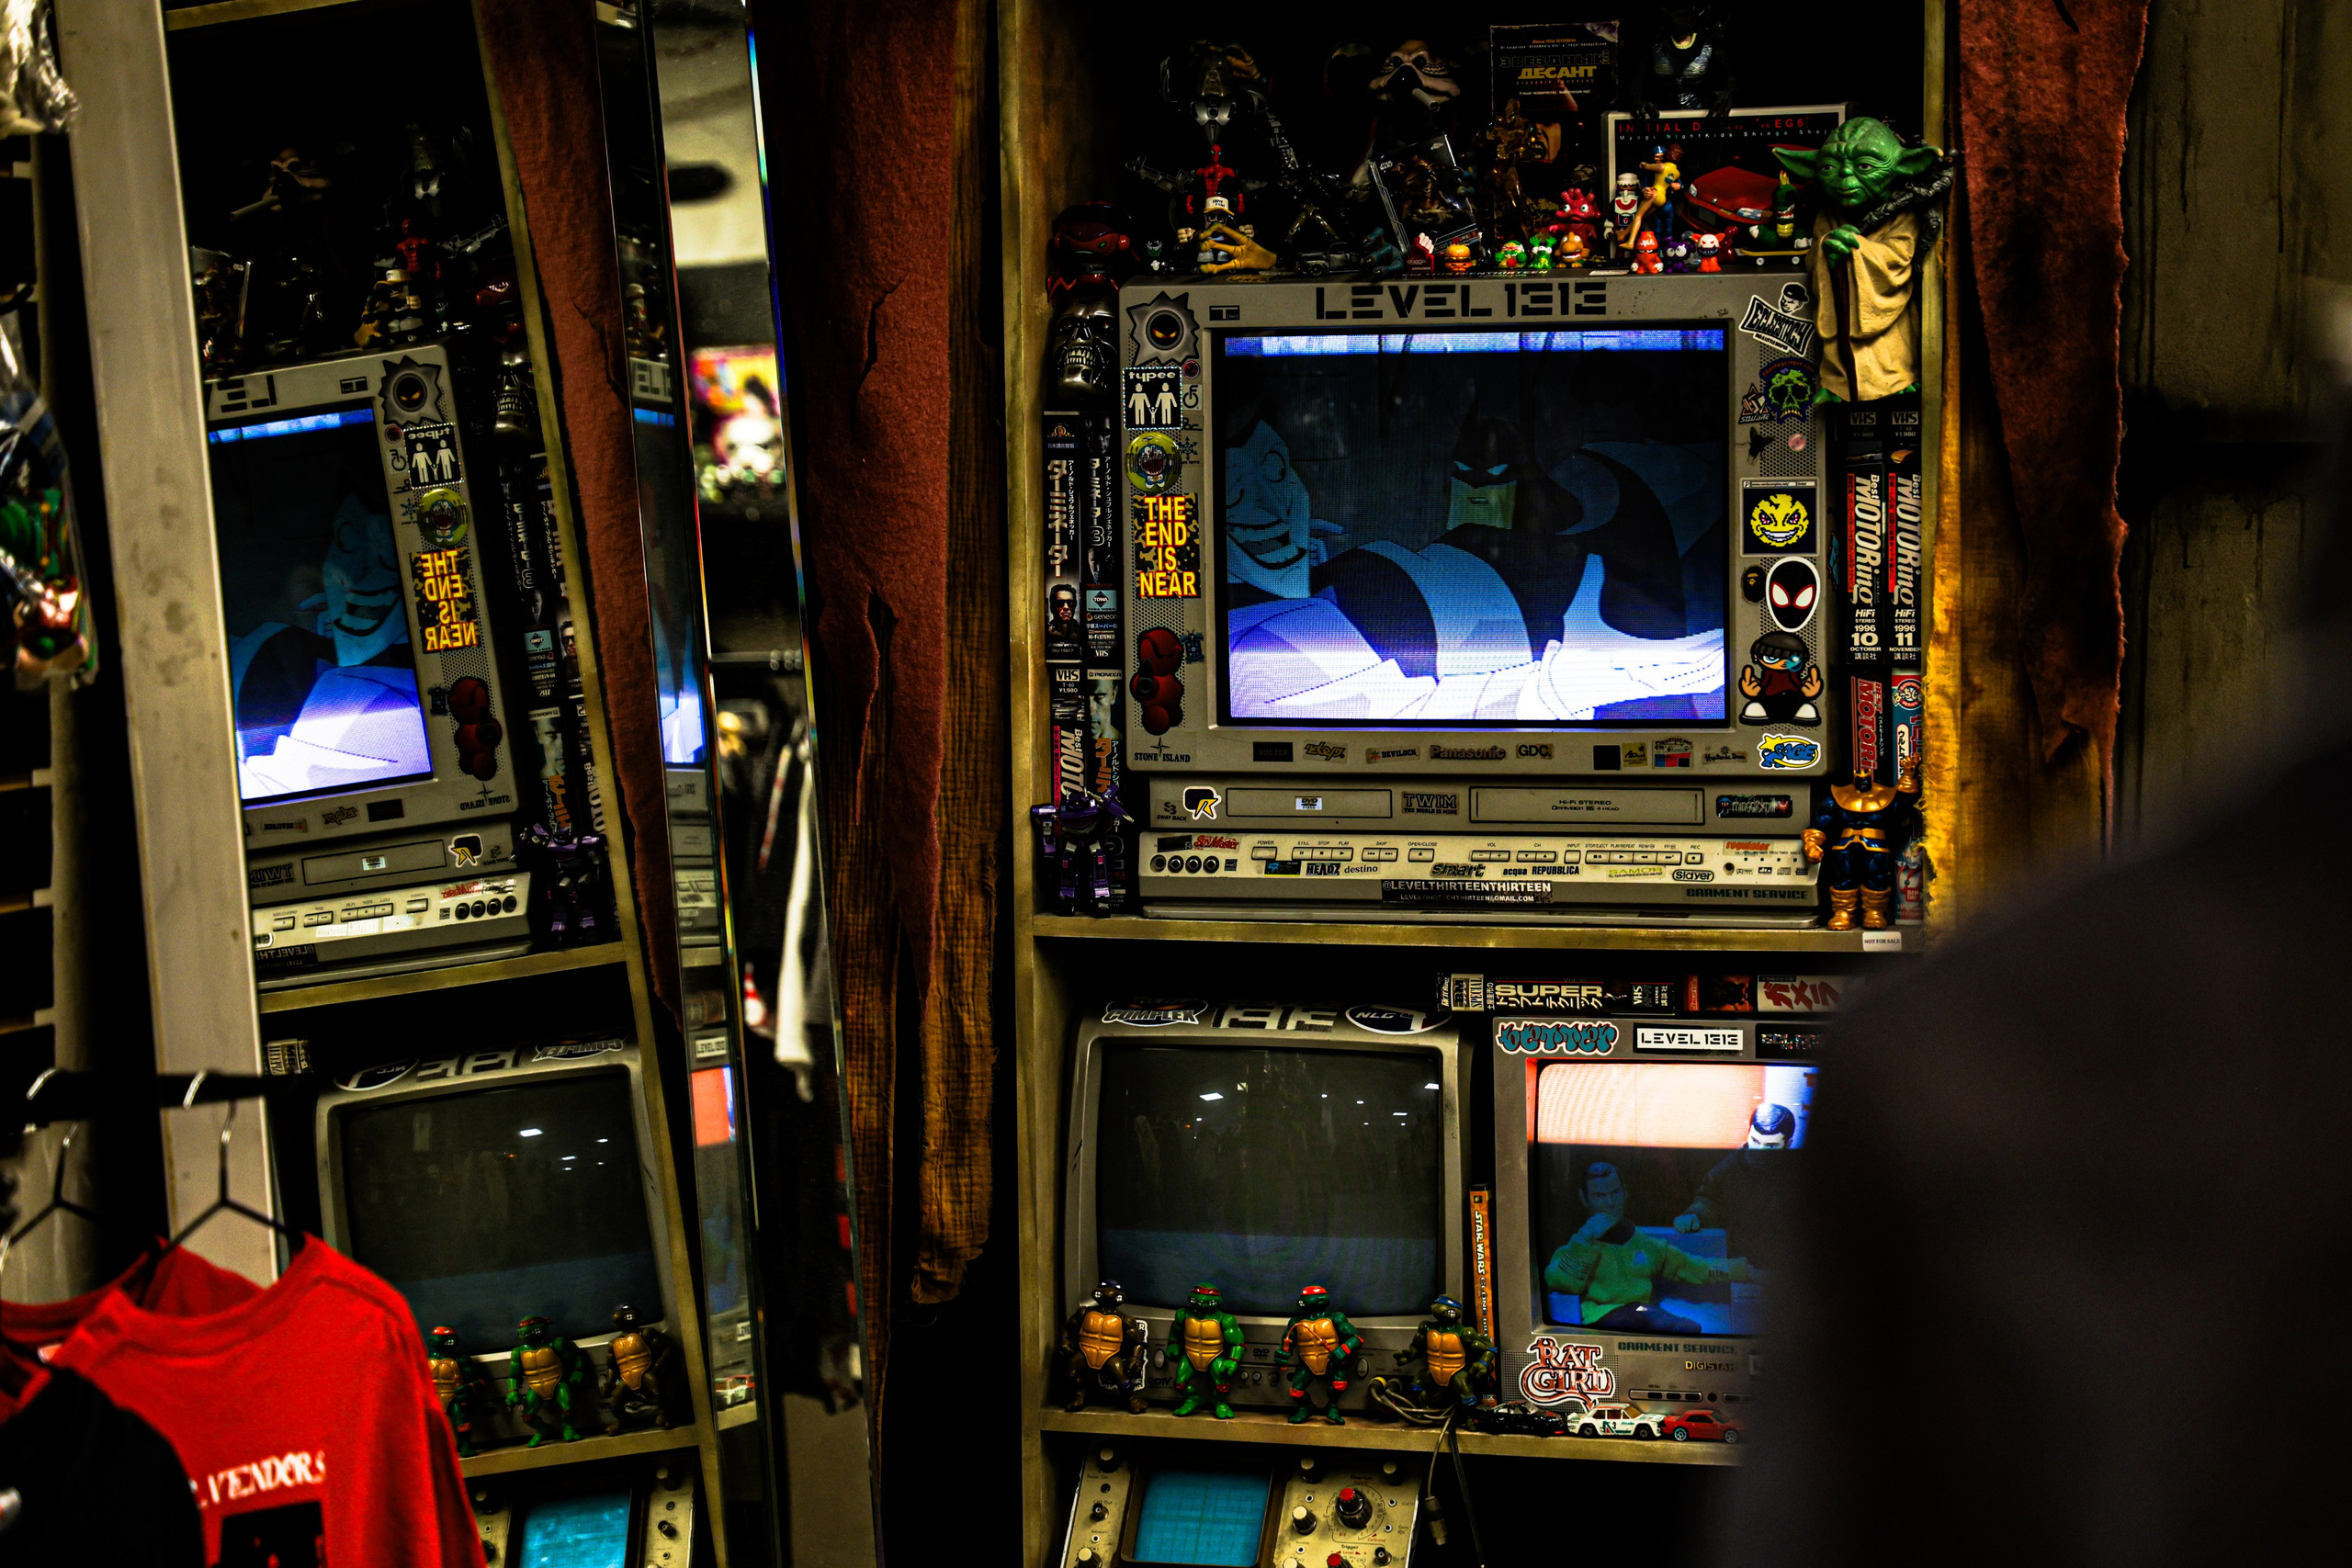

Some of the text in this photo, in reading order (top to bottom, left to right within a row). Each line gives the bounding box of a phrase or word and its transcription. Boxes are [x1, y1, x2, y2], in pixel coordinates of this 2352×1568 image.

[1517, 65, 1598, 80] ДЕСАНТ
[1619, 122, 1682, 133] INTIAL
[1743, 130, 1788, 138] Shingo
[1316, 284, 1492, 320] LEVEL
[1128, 371, 1176, 383] typee
[1851, 412, 1877, 424] VHS
[1893, 412, 1918, 424] VHS
[1870, 473, 1880, 500] Best
[1912, 473, 1921, 500] Best
[1143, 496, 1187, 522] THE
[1046, 458, 1069, 578] ターミネーター
[1145, 521, 1188, 547] END
[1157, 547, 1177, 572] IS
[1139, 571, 1198, 597] NEAR
[1855, 609, 1876, 618] HiFi
[1894, 609, 1917, 618] HiFi
[1851, 632, 1880, 647] 10
[1894, 632, 1914, 647] 11
[1094, 649, 1110, 658] VHS
[1854, 652, 1877, 660] 講談社
[1894, 652, 1917, 660] 講談社
[1057, 670, 1080, 681] VHS
[1074, 728, 1083, 753] Best
[1134, 752, 1191, 763] STONE ISLAND
[1430, 745, 1506, 761] Panasonic
[1404, 793, 1457, 808] TWIM
[1306, 863, 1340, 875] HEADZ
[1344, 864, 1379, 874] destino
[1430, 863, 1487, 877] smart
[1502, 866, 1579, 876] acqua REPUBBLICA
[1675, 871, 1713, 883] Slayer
[1382, 880, 1552, 893] @LEVELTHIRTEENTHIRTEEN
[1686, 887, 1808, 900] GARMENT SERVICE
[1470, 976, 1483, 1009] SPECIAL
[1495, 984, 1603, 998] SUPER
[1633, 985, 1644, 1006] VHS
[1496, 996, 1603, 1010] ドリフトテクニック
[1102, 1009, 1199, 1026] COMPLEX
[1641, 1032, 1702, 1045] LEVEL
[1475, 1210, 1486, 1276] STAR WARS
[1531, 1337, 1602, 1370] RAT
[1618, 1341, 1679, 1353] GARMENT
[1611, 1421, 1617, 1430] 3
